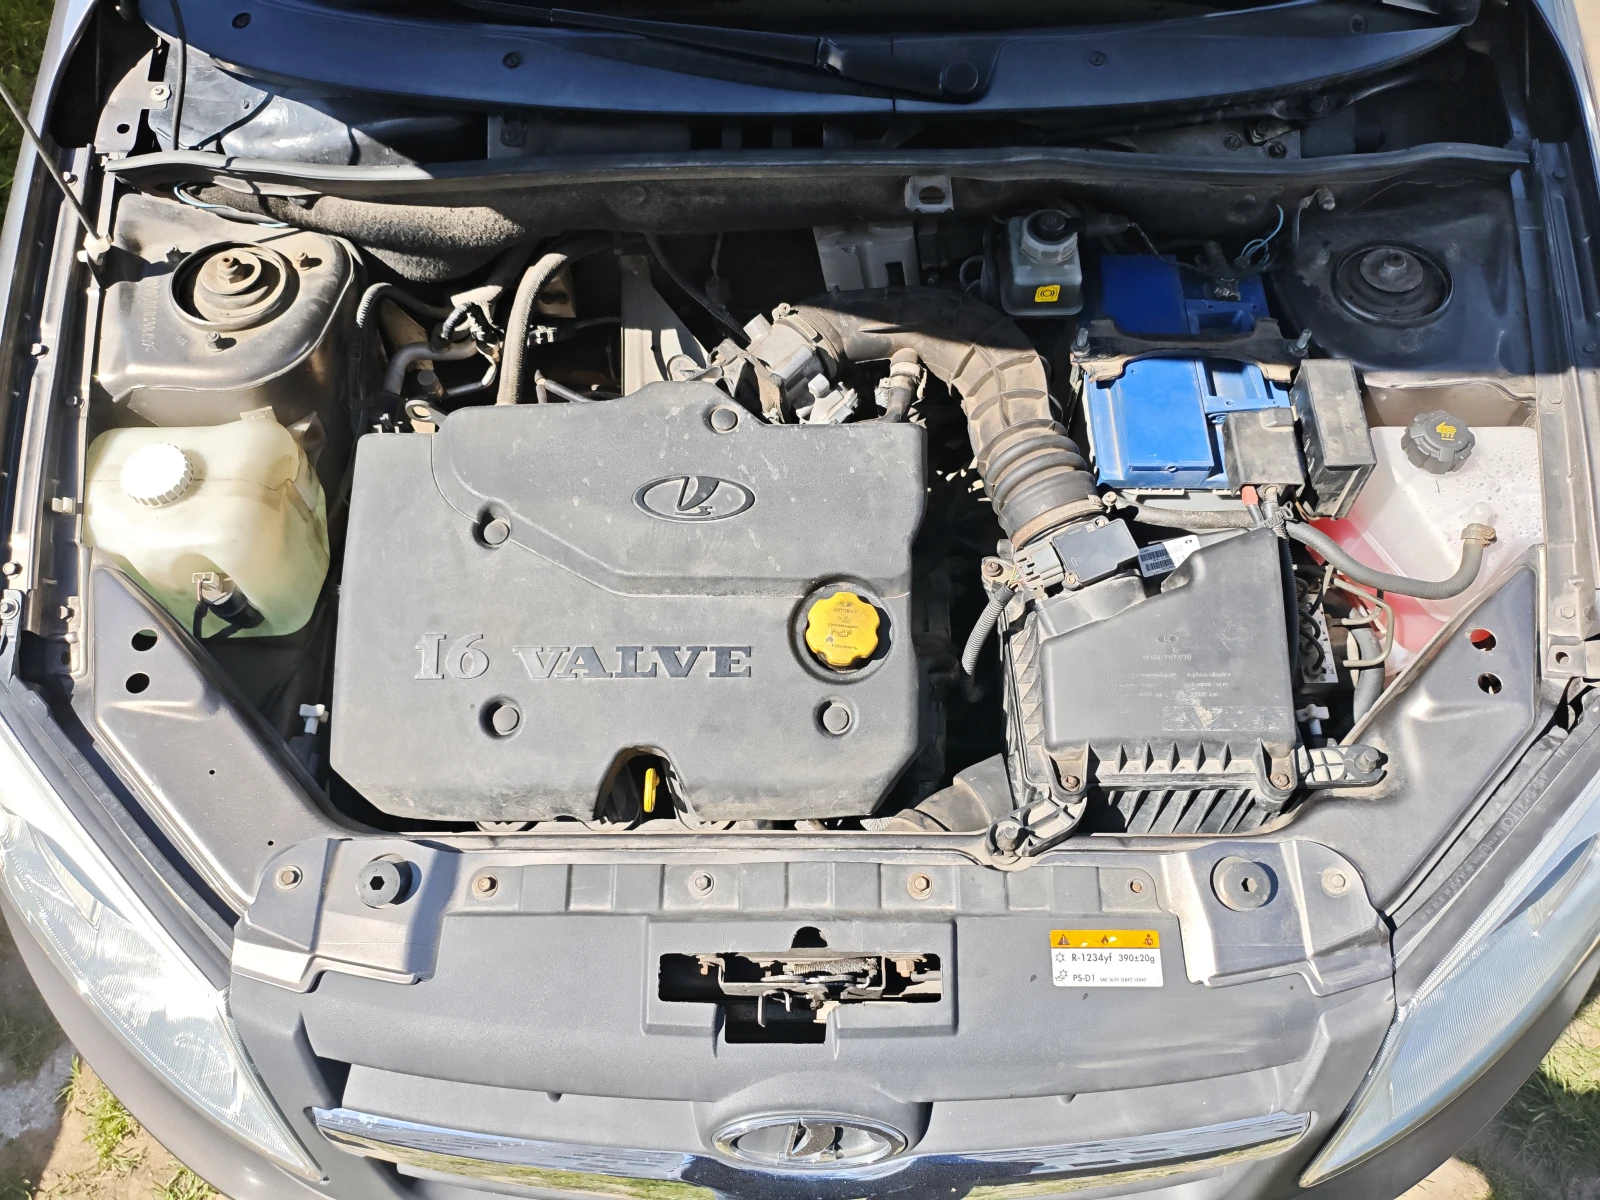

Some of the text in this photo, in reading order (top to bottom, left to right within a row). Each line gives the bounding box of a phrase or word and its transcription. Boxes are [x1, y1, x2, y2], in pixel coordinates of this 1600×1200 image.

[414, 633, 752, 680] 16 VALVE
[1071, 952, 1155, 964] R-1234yf 390±20g
[1072, 973, 1095, 983] PS-D1
